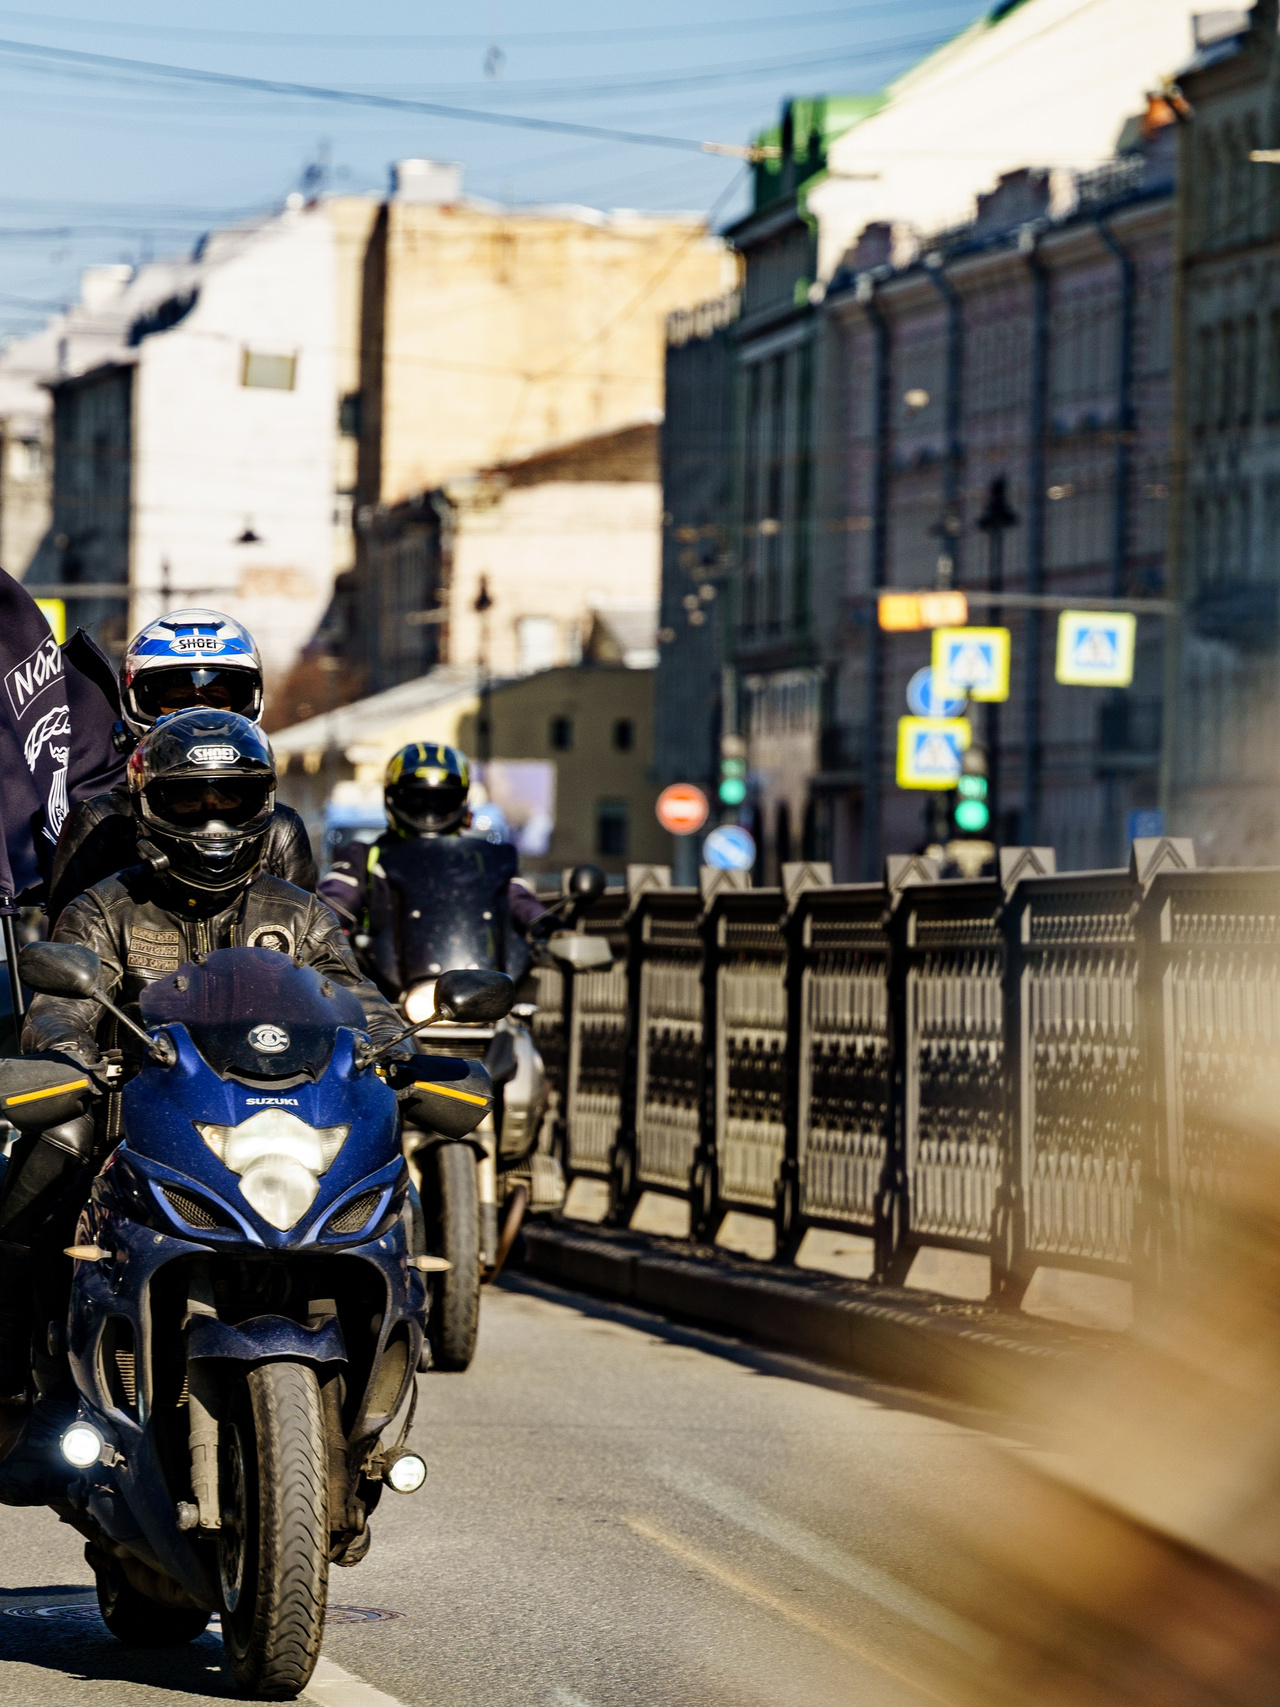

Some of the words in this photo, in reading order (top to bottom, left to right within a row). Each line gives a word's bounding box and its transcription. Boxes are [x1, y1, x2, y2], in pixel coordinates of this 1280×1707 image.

[179, 638, 217, 650] SHOEI
[193, 747, 234, 761] SHOEI
[245, 1097, 299, 1107] SUZUKI
